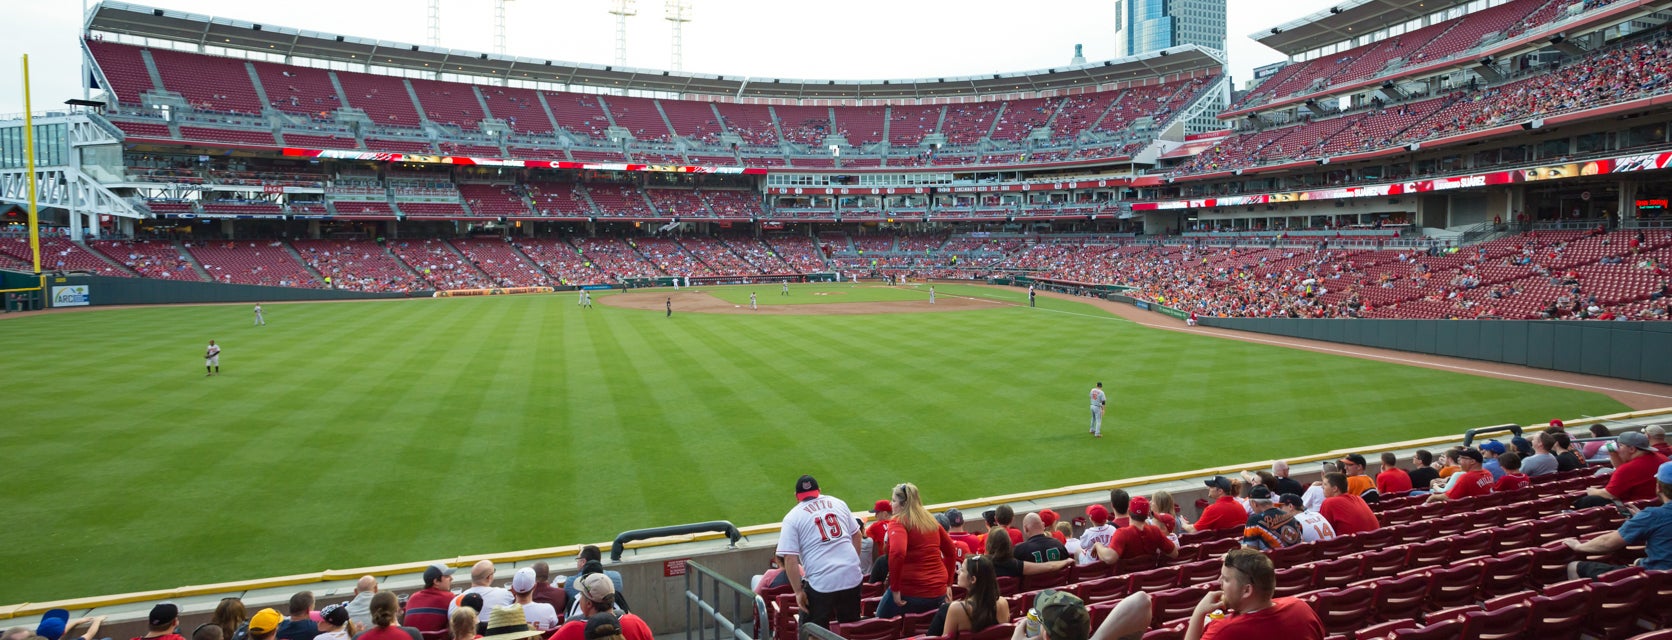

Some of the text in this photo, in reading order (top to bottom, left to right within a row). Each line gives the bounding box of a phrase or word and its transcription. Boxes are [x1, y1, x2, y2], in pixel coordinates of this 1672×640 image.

[1476, 475, 1494, 488] PHILL
[803, 500, 833, 514] VOTTO
[814, 512, 843, 543] 19
[1313, 522, 1334, 541] 14
[1090, 534, 1113, 544] VOTT
